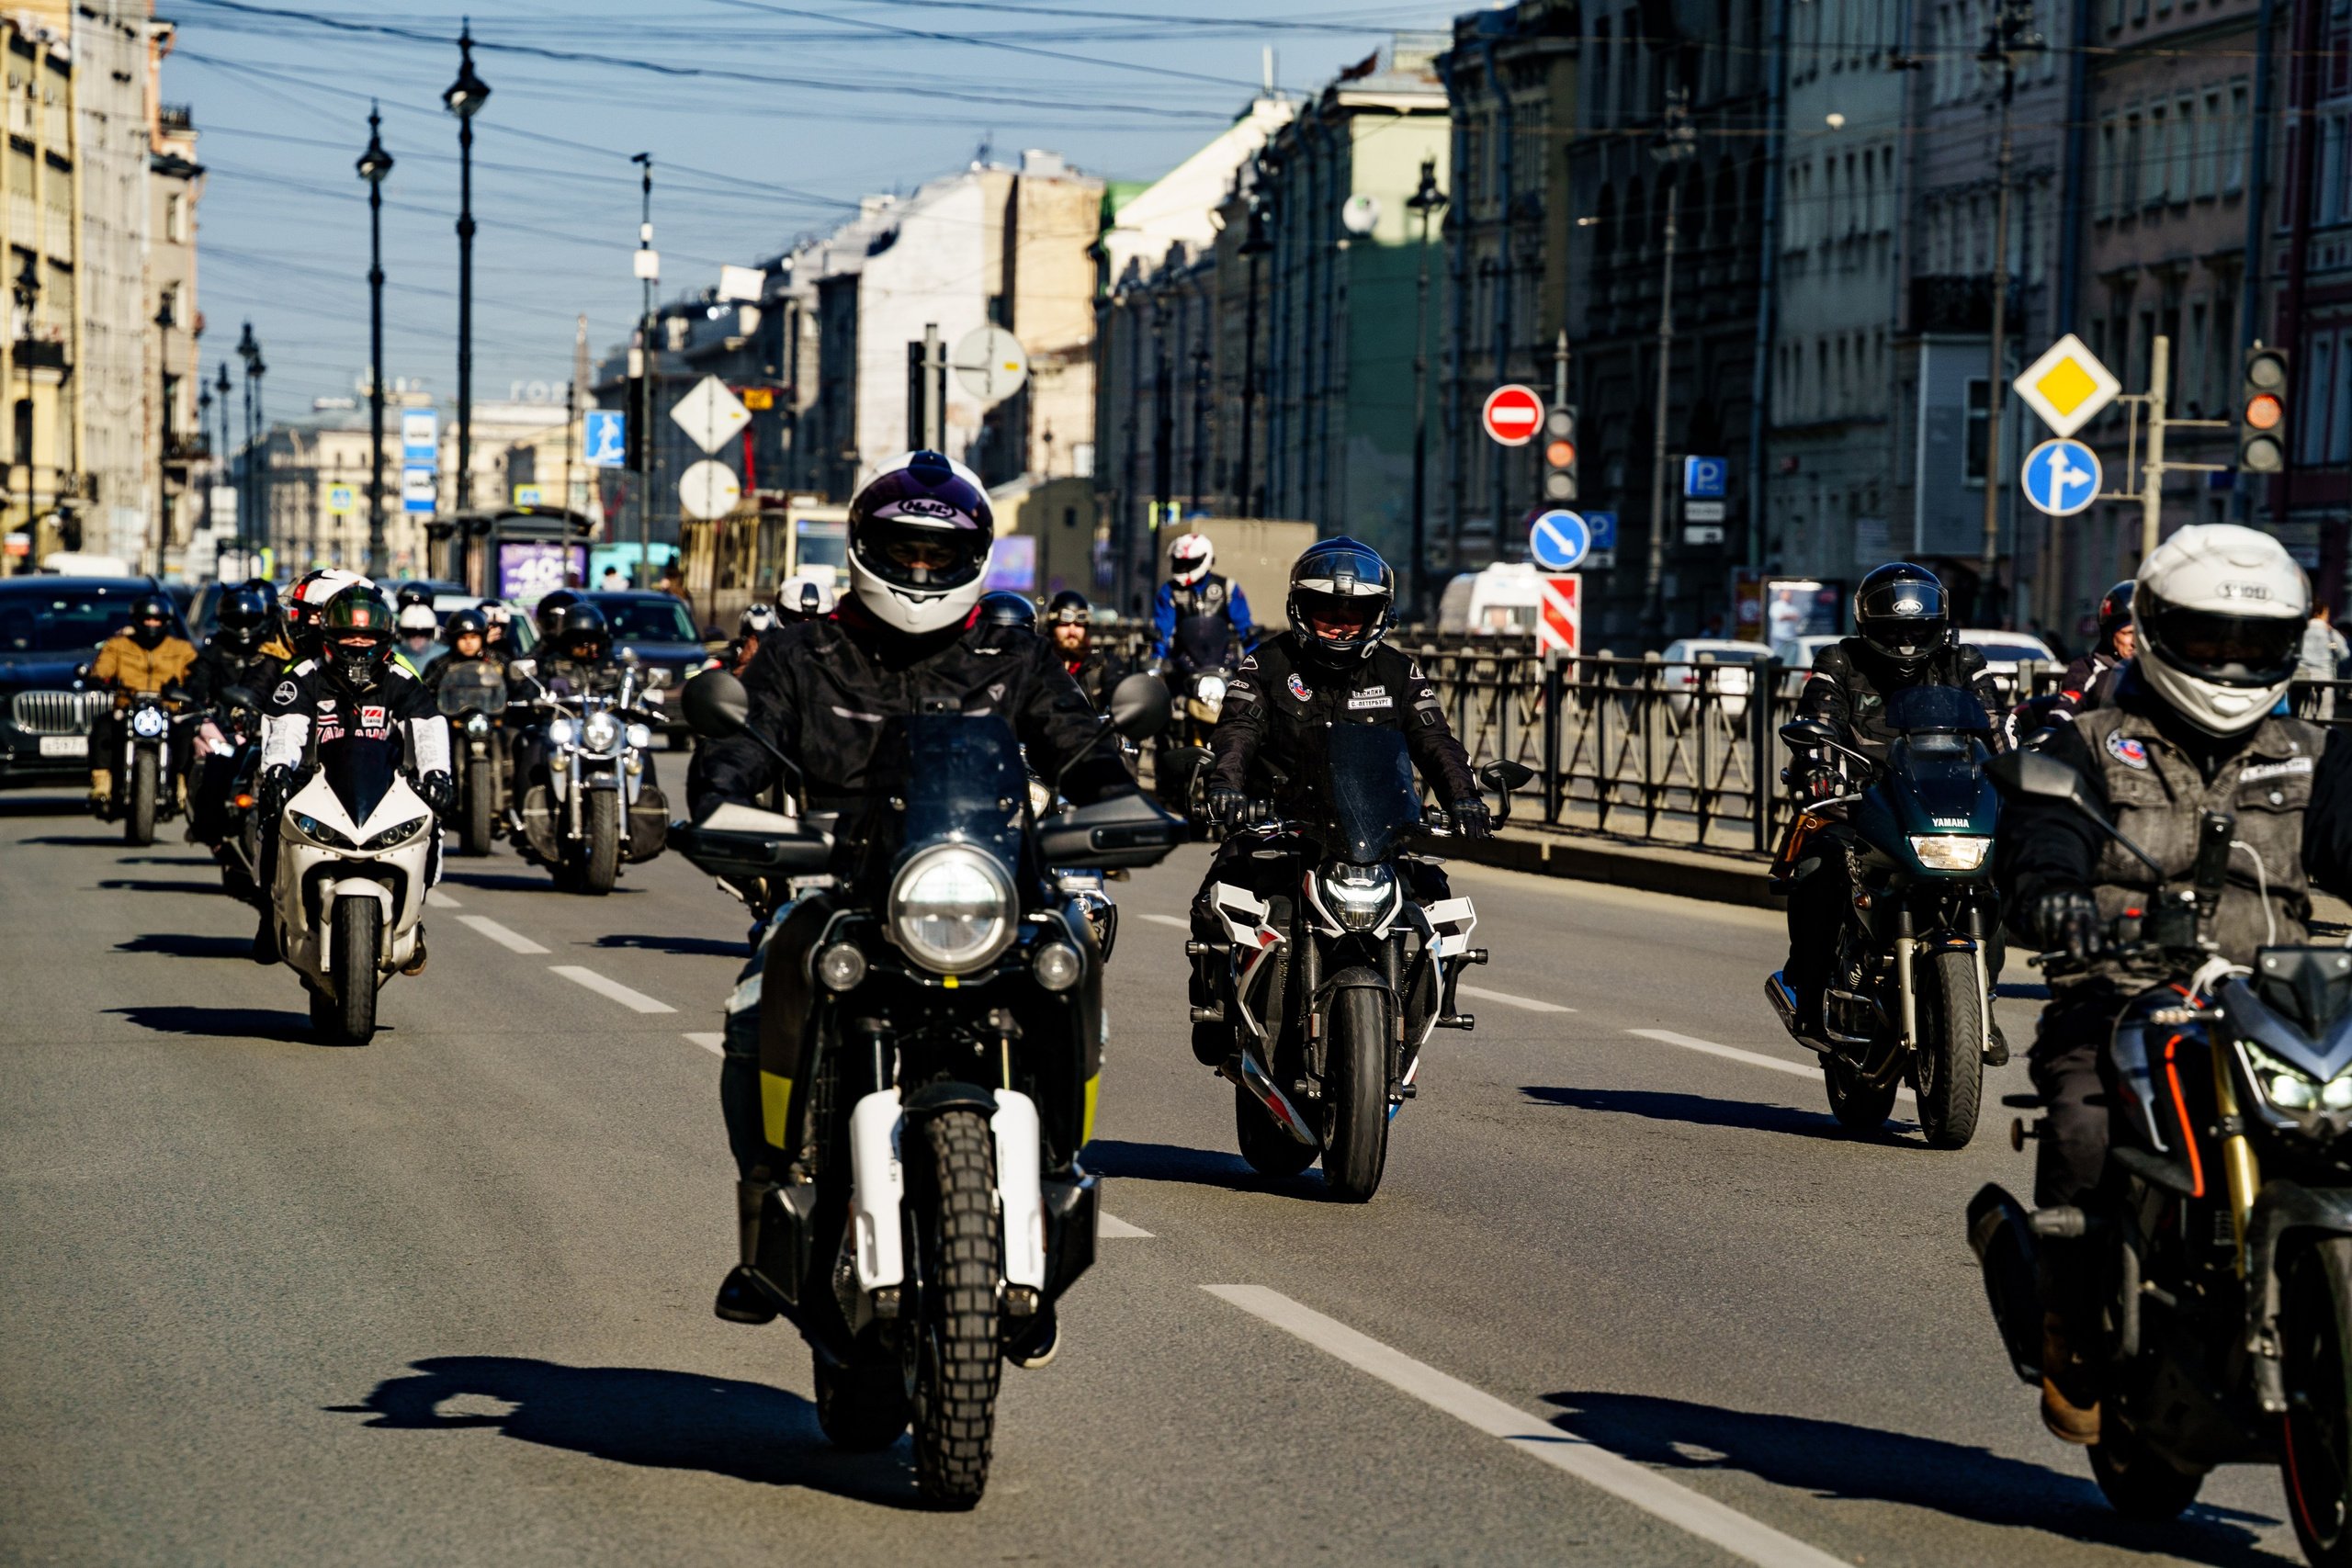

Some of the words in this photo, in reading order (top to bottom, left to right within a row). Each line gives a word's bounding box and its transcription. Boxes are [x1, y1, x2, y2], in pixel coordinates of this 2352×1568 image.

[1697, 462, 1718, 491] P
[906, 502, 949, 513] HJC
[1932, 818, 1970, 829] YAMAHA
